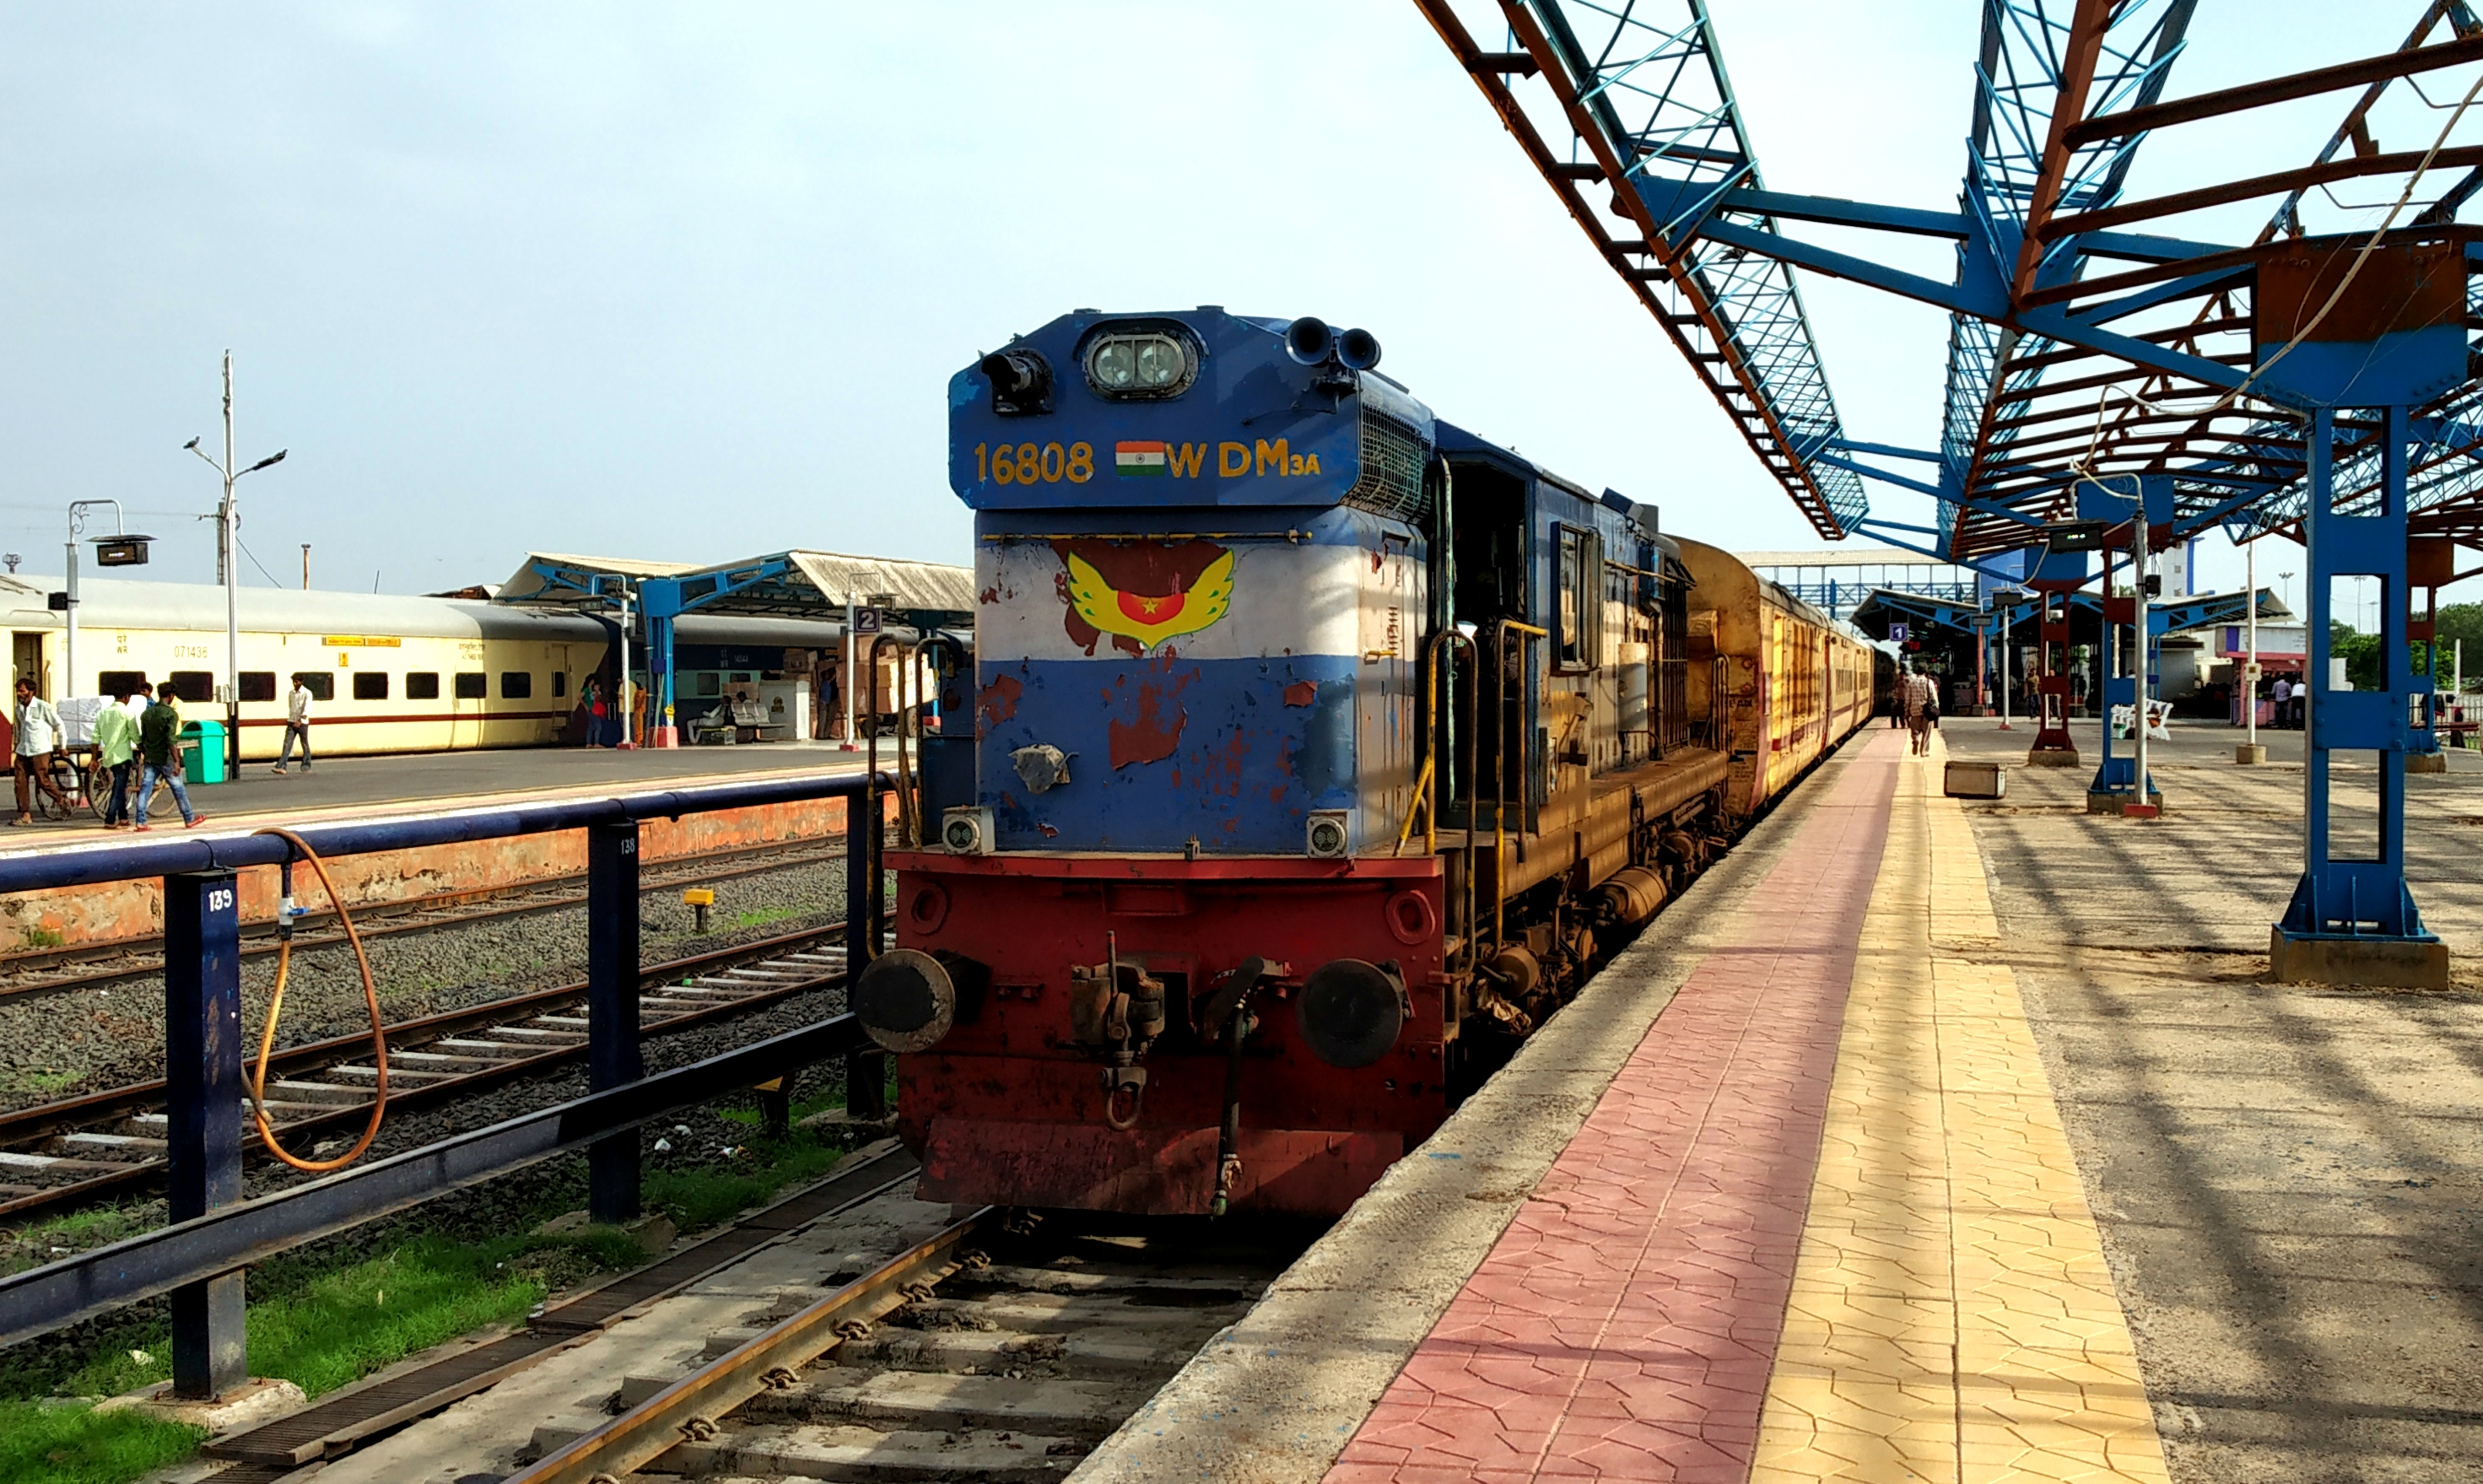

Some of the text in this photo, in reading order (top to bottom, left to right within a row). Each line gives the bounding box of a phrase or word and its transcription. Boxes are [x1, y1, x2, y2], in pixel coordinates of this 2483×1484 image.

[975, 442, 1094, 484] 16808
[861, 612, 875, 629] 2
[1894, 628, 1903, 639] 1
[116, 645, 127, 654] WR
[174, 645, 208, 658] 071436
[620, 837, 635, 855] 138
[208, 889, 232, 912] 139
